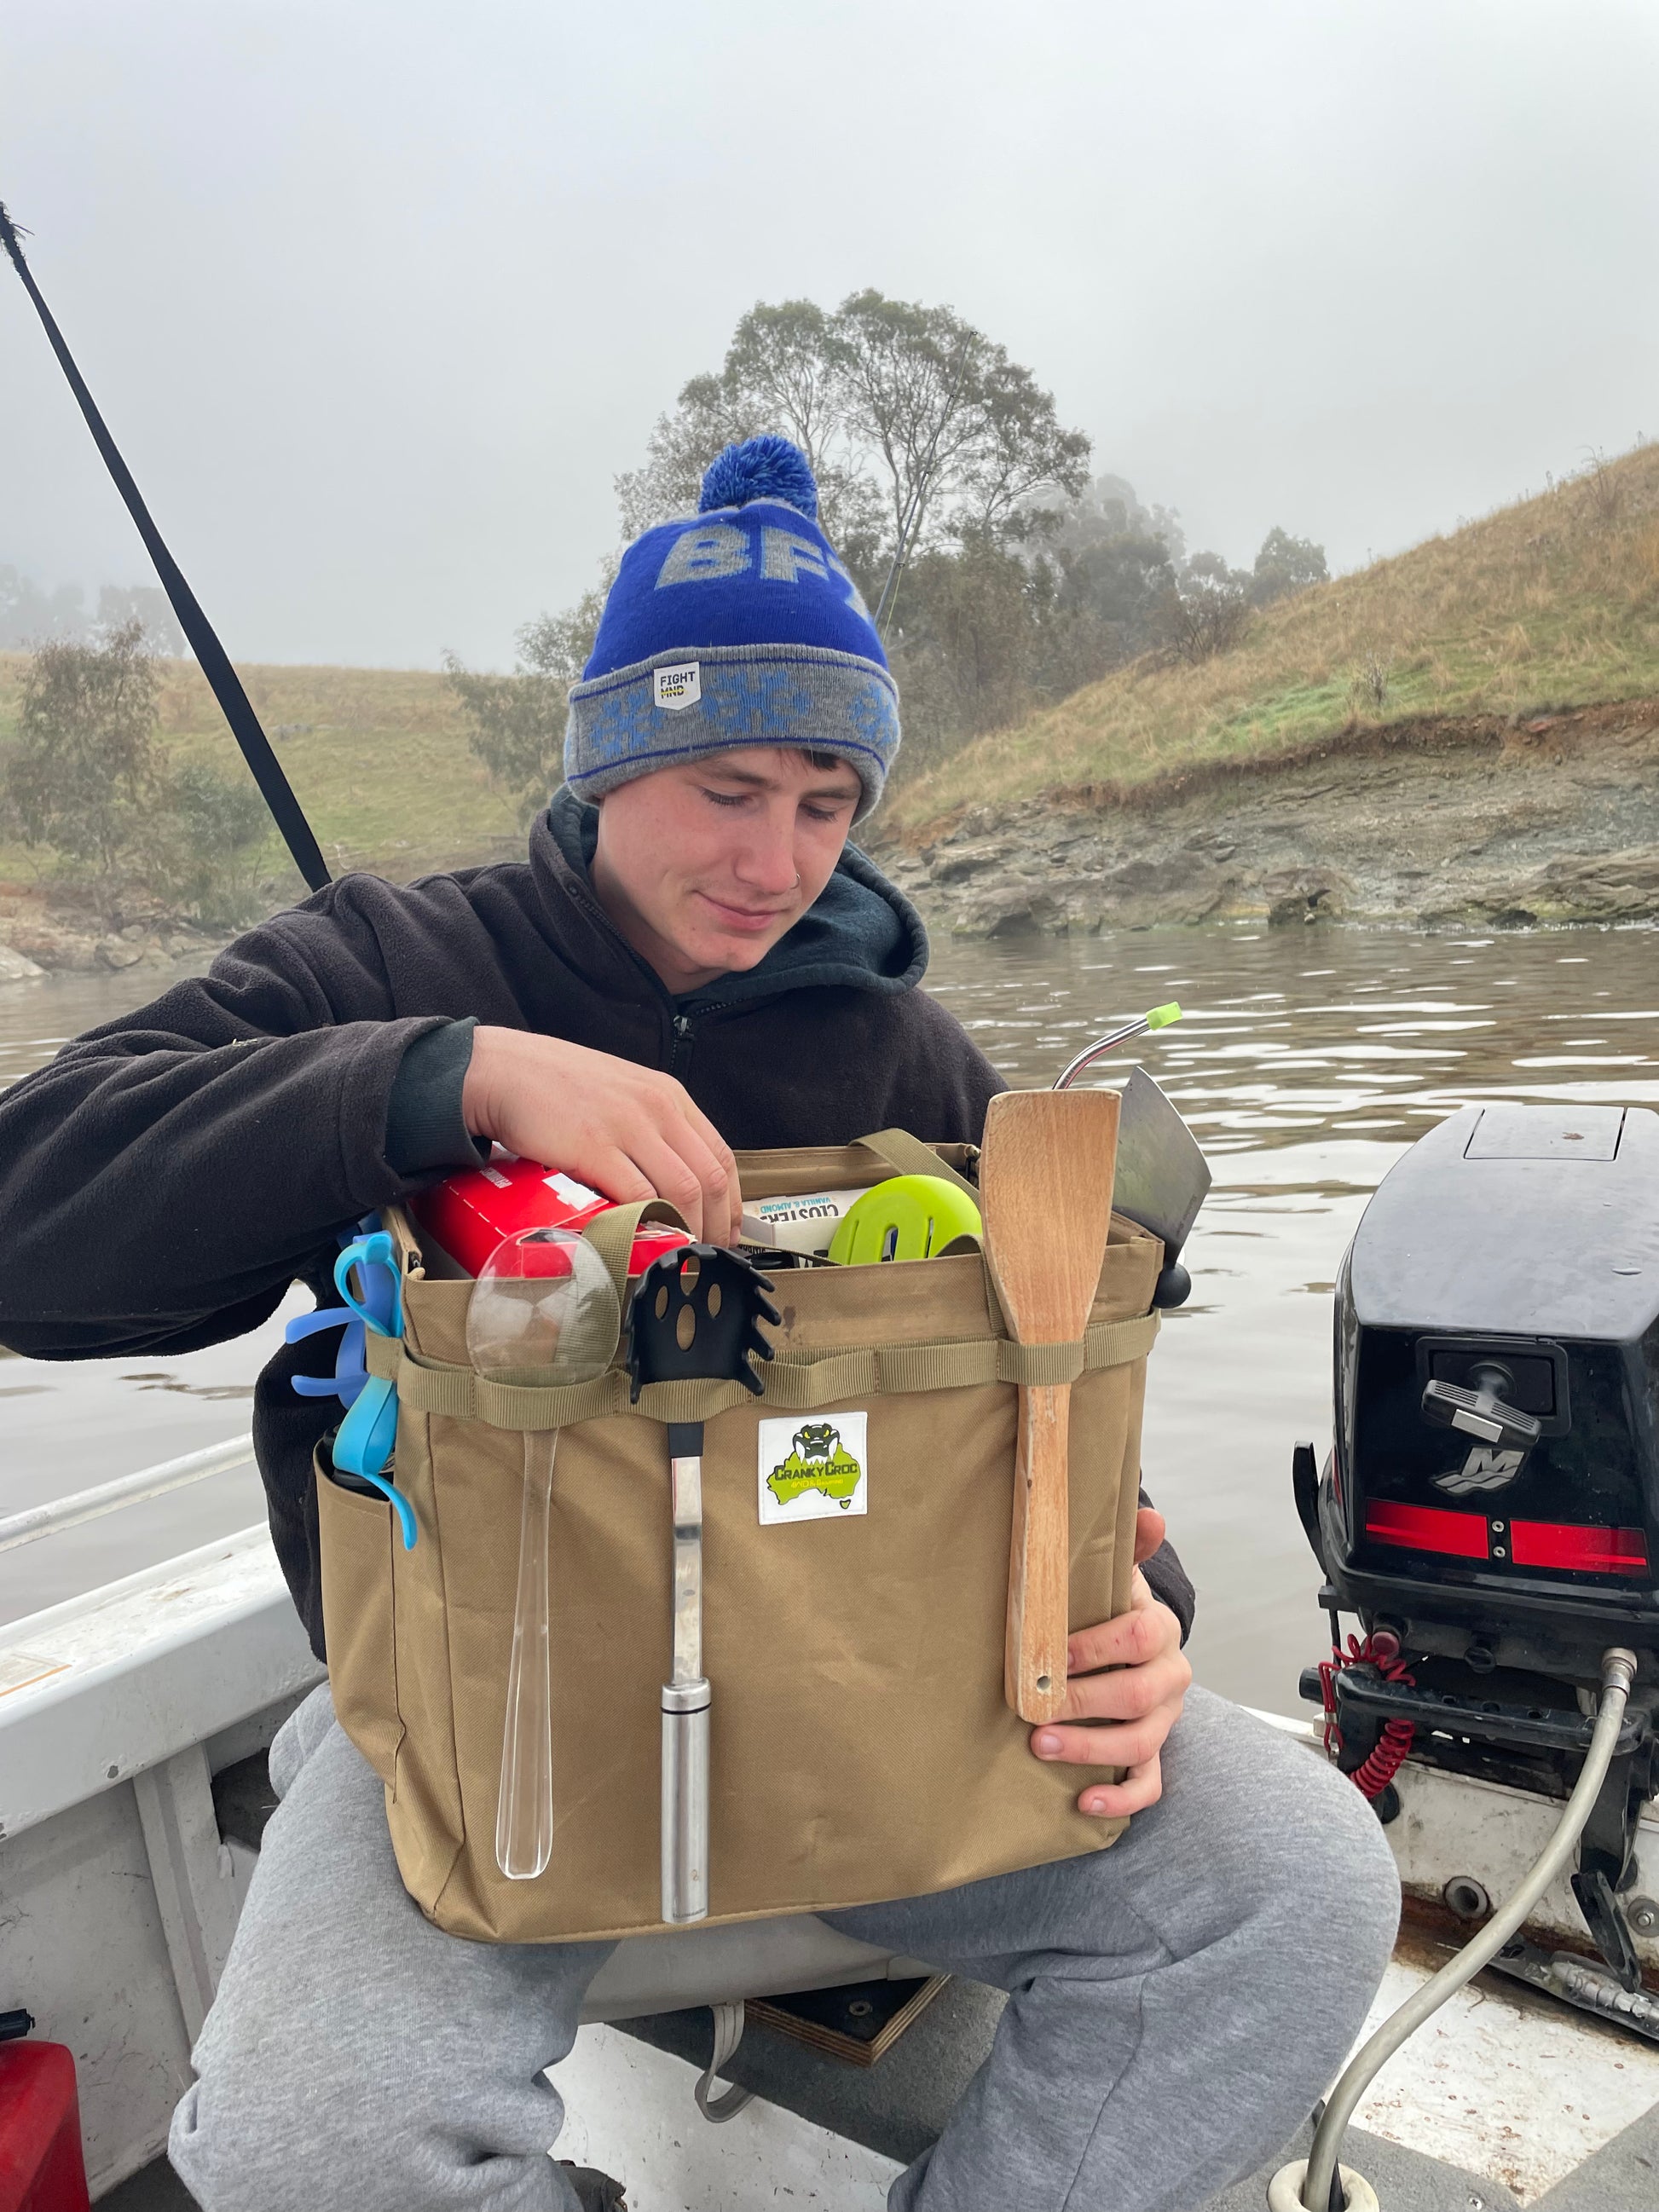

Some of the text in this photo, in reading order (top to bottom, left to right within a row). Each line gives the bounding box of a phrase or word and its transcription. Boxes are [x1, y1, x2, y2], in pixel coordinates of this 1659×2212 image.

[660, 671, 696, 687] FIGHT
[660, 684, 685, 700] MND
[760, 1202, 791, 1214] ALMOND
[801, 1197, 830, 1206] VANILLA
[774, 1461, 858, 1481] CRANKY CROC
